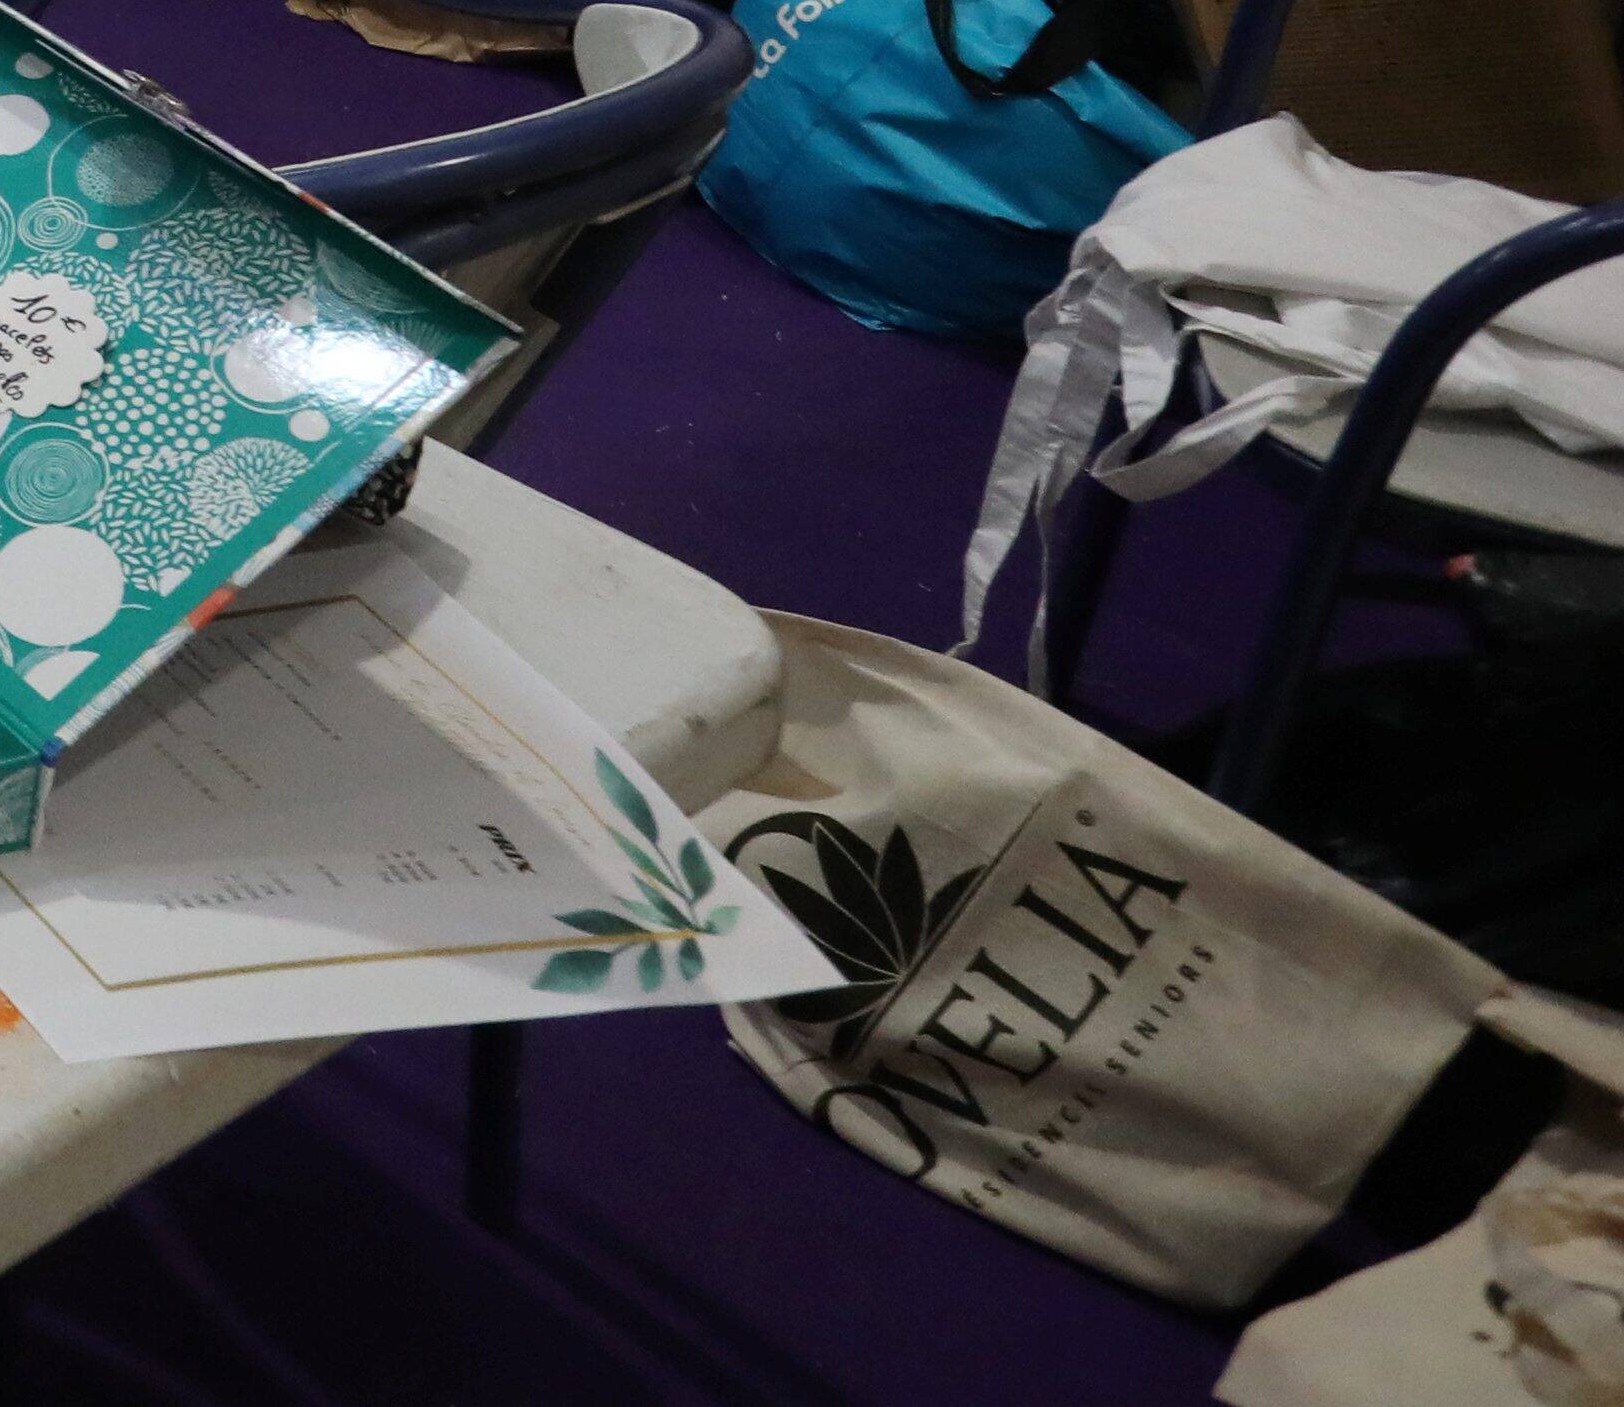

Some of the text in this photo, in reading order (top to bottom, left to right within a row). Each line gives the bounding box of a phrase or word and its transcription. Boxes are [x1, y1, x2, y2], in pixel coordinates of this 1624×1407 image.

[10, 294, 58, 324] 10
[477, 823, 537, 875] PRIX
[817, 820, 1190, 1179] OVELIA
[1103, 943, 1216, 1076] SENIORS
